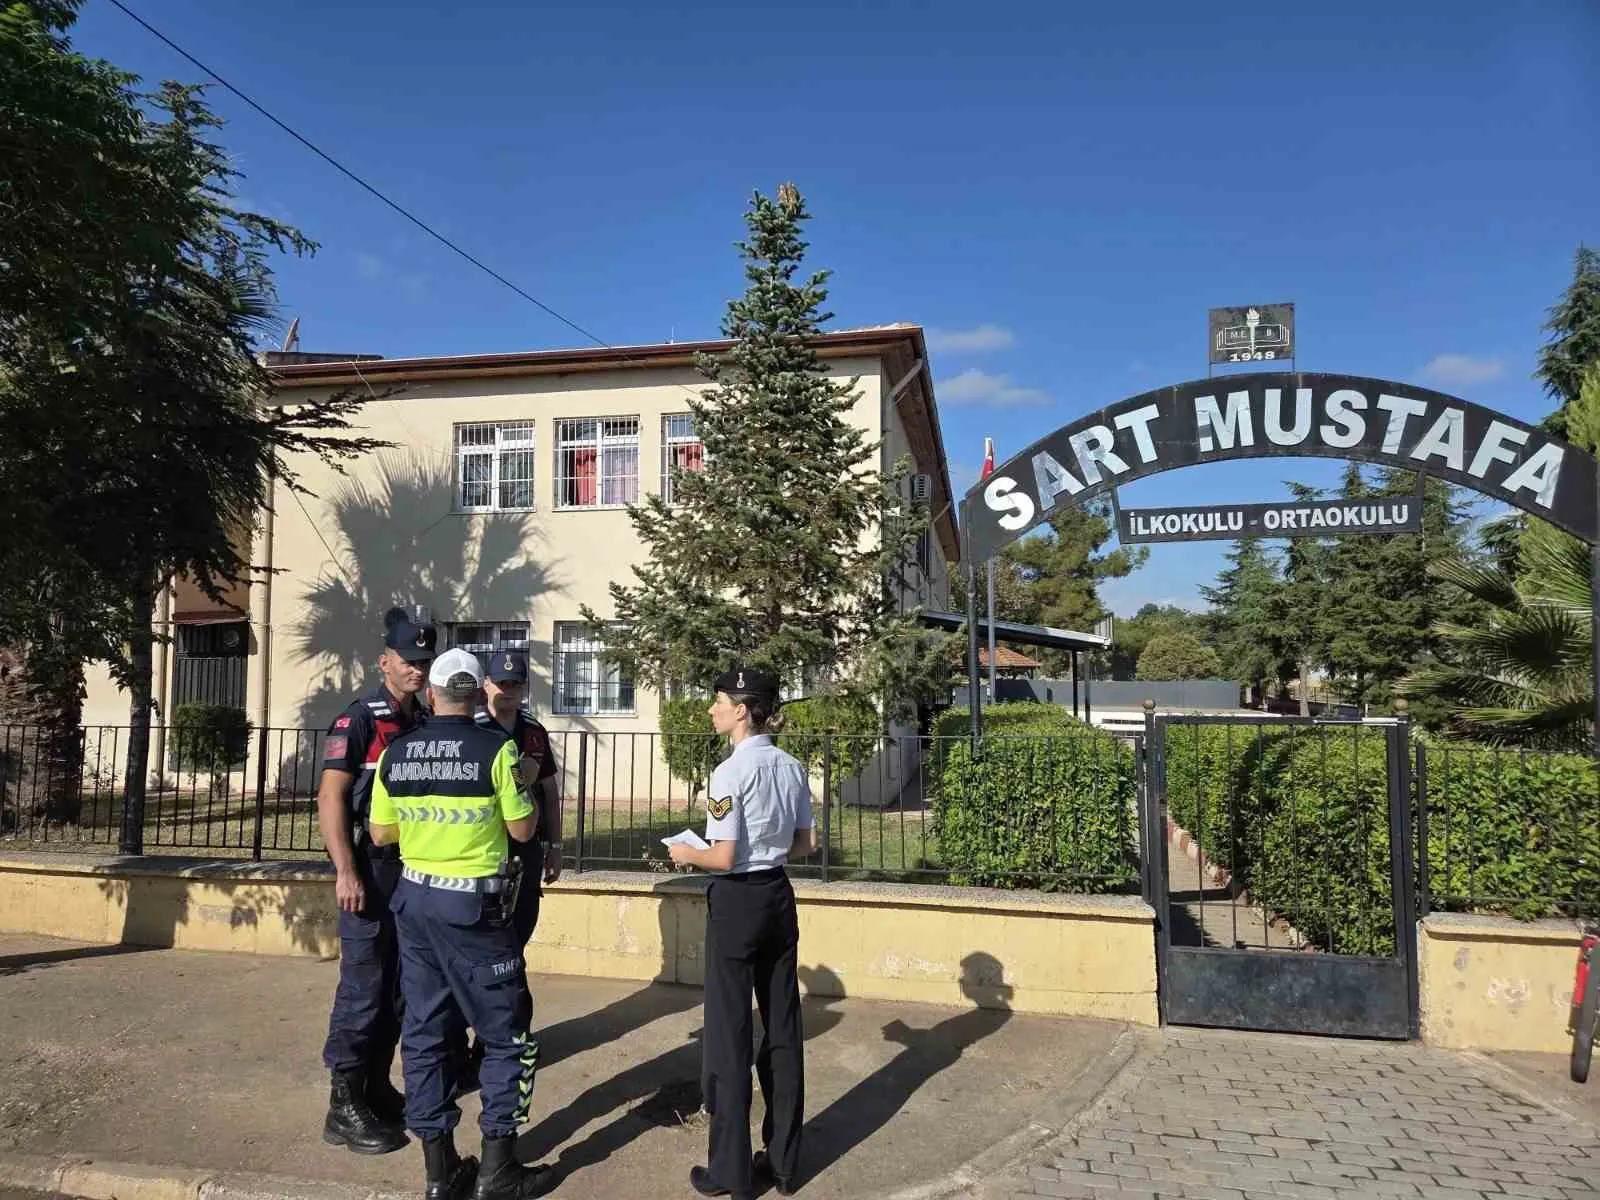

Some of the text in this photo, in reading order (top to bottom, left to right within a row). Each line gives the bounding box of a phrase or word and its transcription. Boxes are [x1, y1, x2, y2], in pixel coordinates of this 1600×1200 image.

[1230, 351, 1275, 362] 1948
[984, 388, 1565, 530] SART MUSTAFA
[1130, 511, 1243, 535] İLKOKULU
[1263, 504, 1409, 530] ORTAOKULU
[388, 761, 479, 781] JANDARMASI
